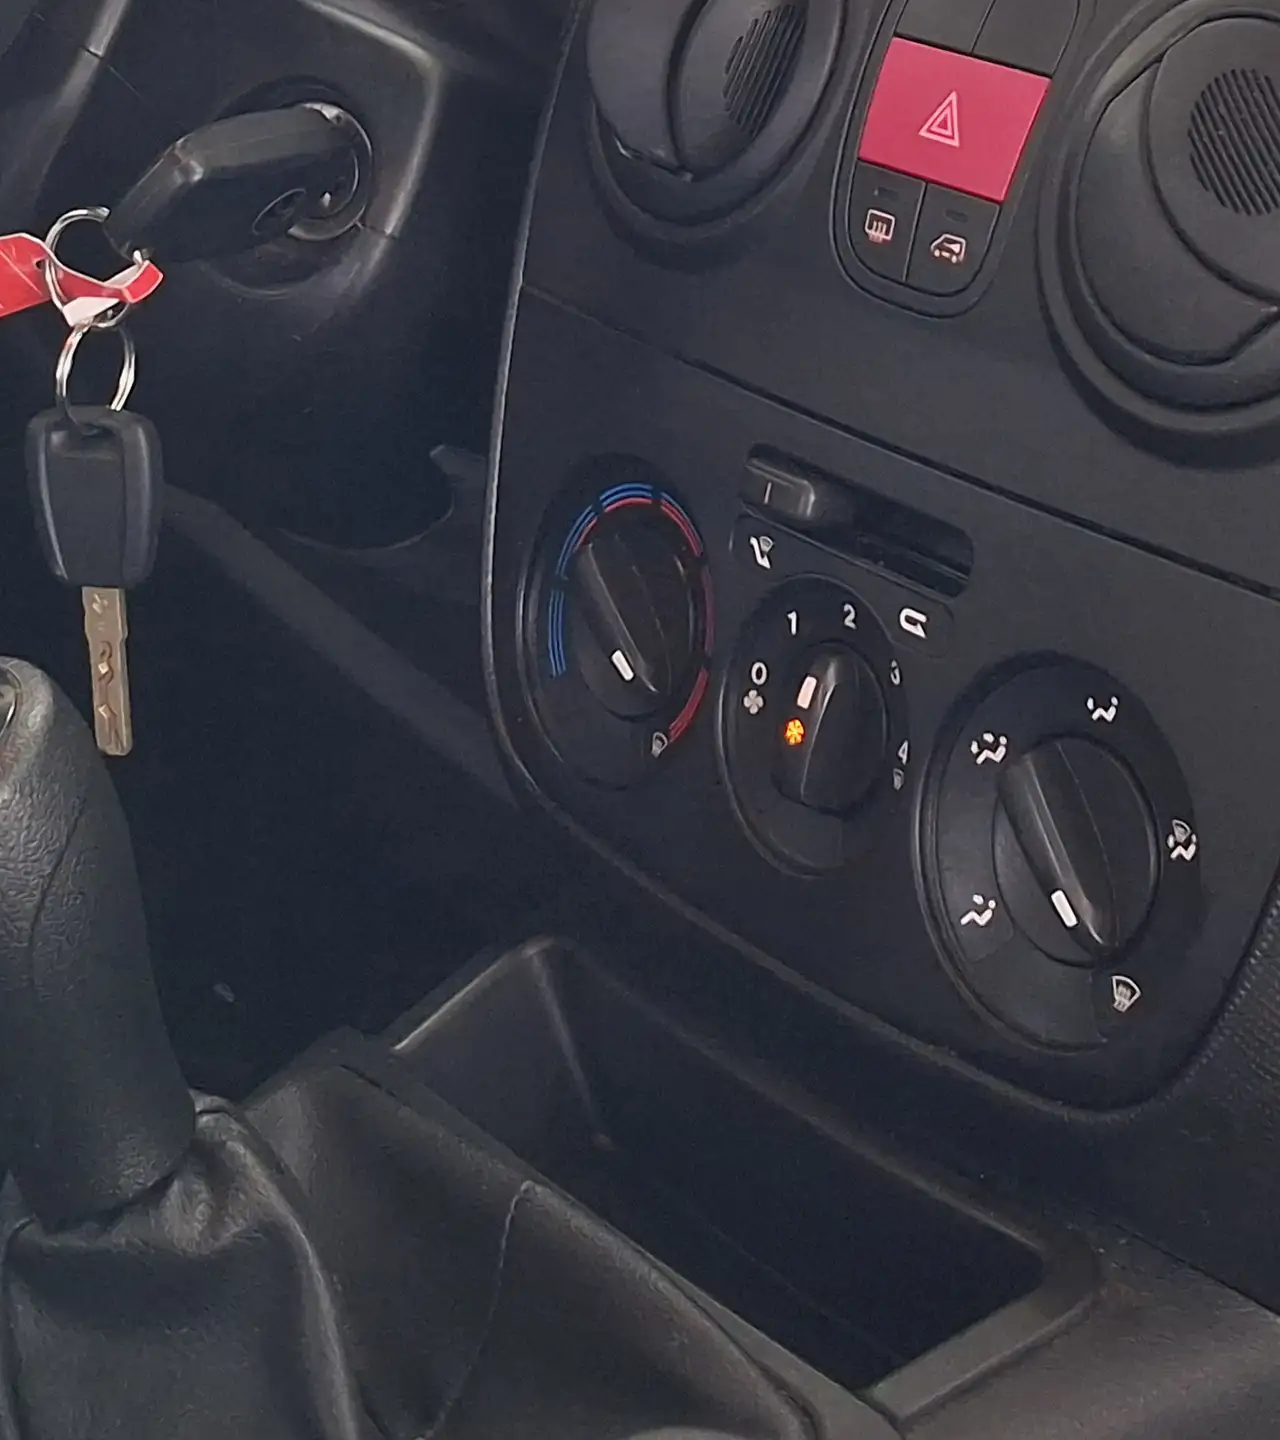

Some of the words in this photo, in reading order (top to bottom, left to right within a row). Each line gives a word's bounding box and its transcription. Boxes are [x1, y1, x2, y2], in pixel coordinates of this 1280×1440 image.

[787, 610, 799, 636] 1
[842, 603, 858, 630] 2
[751, 662, 768, 686] 0
[897, 739, 910, 766] 4
